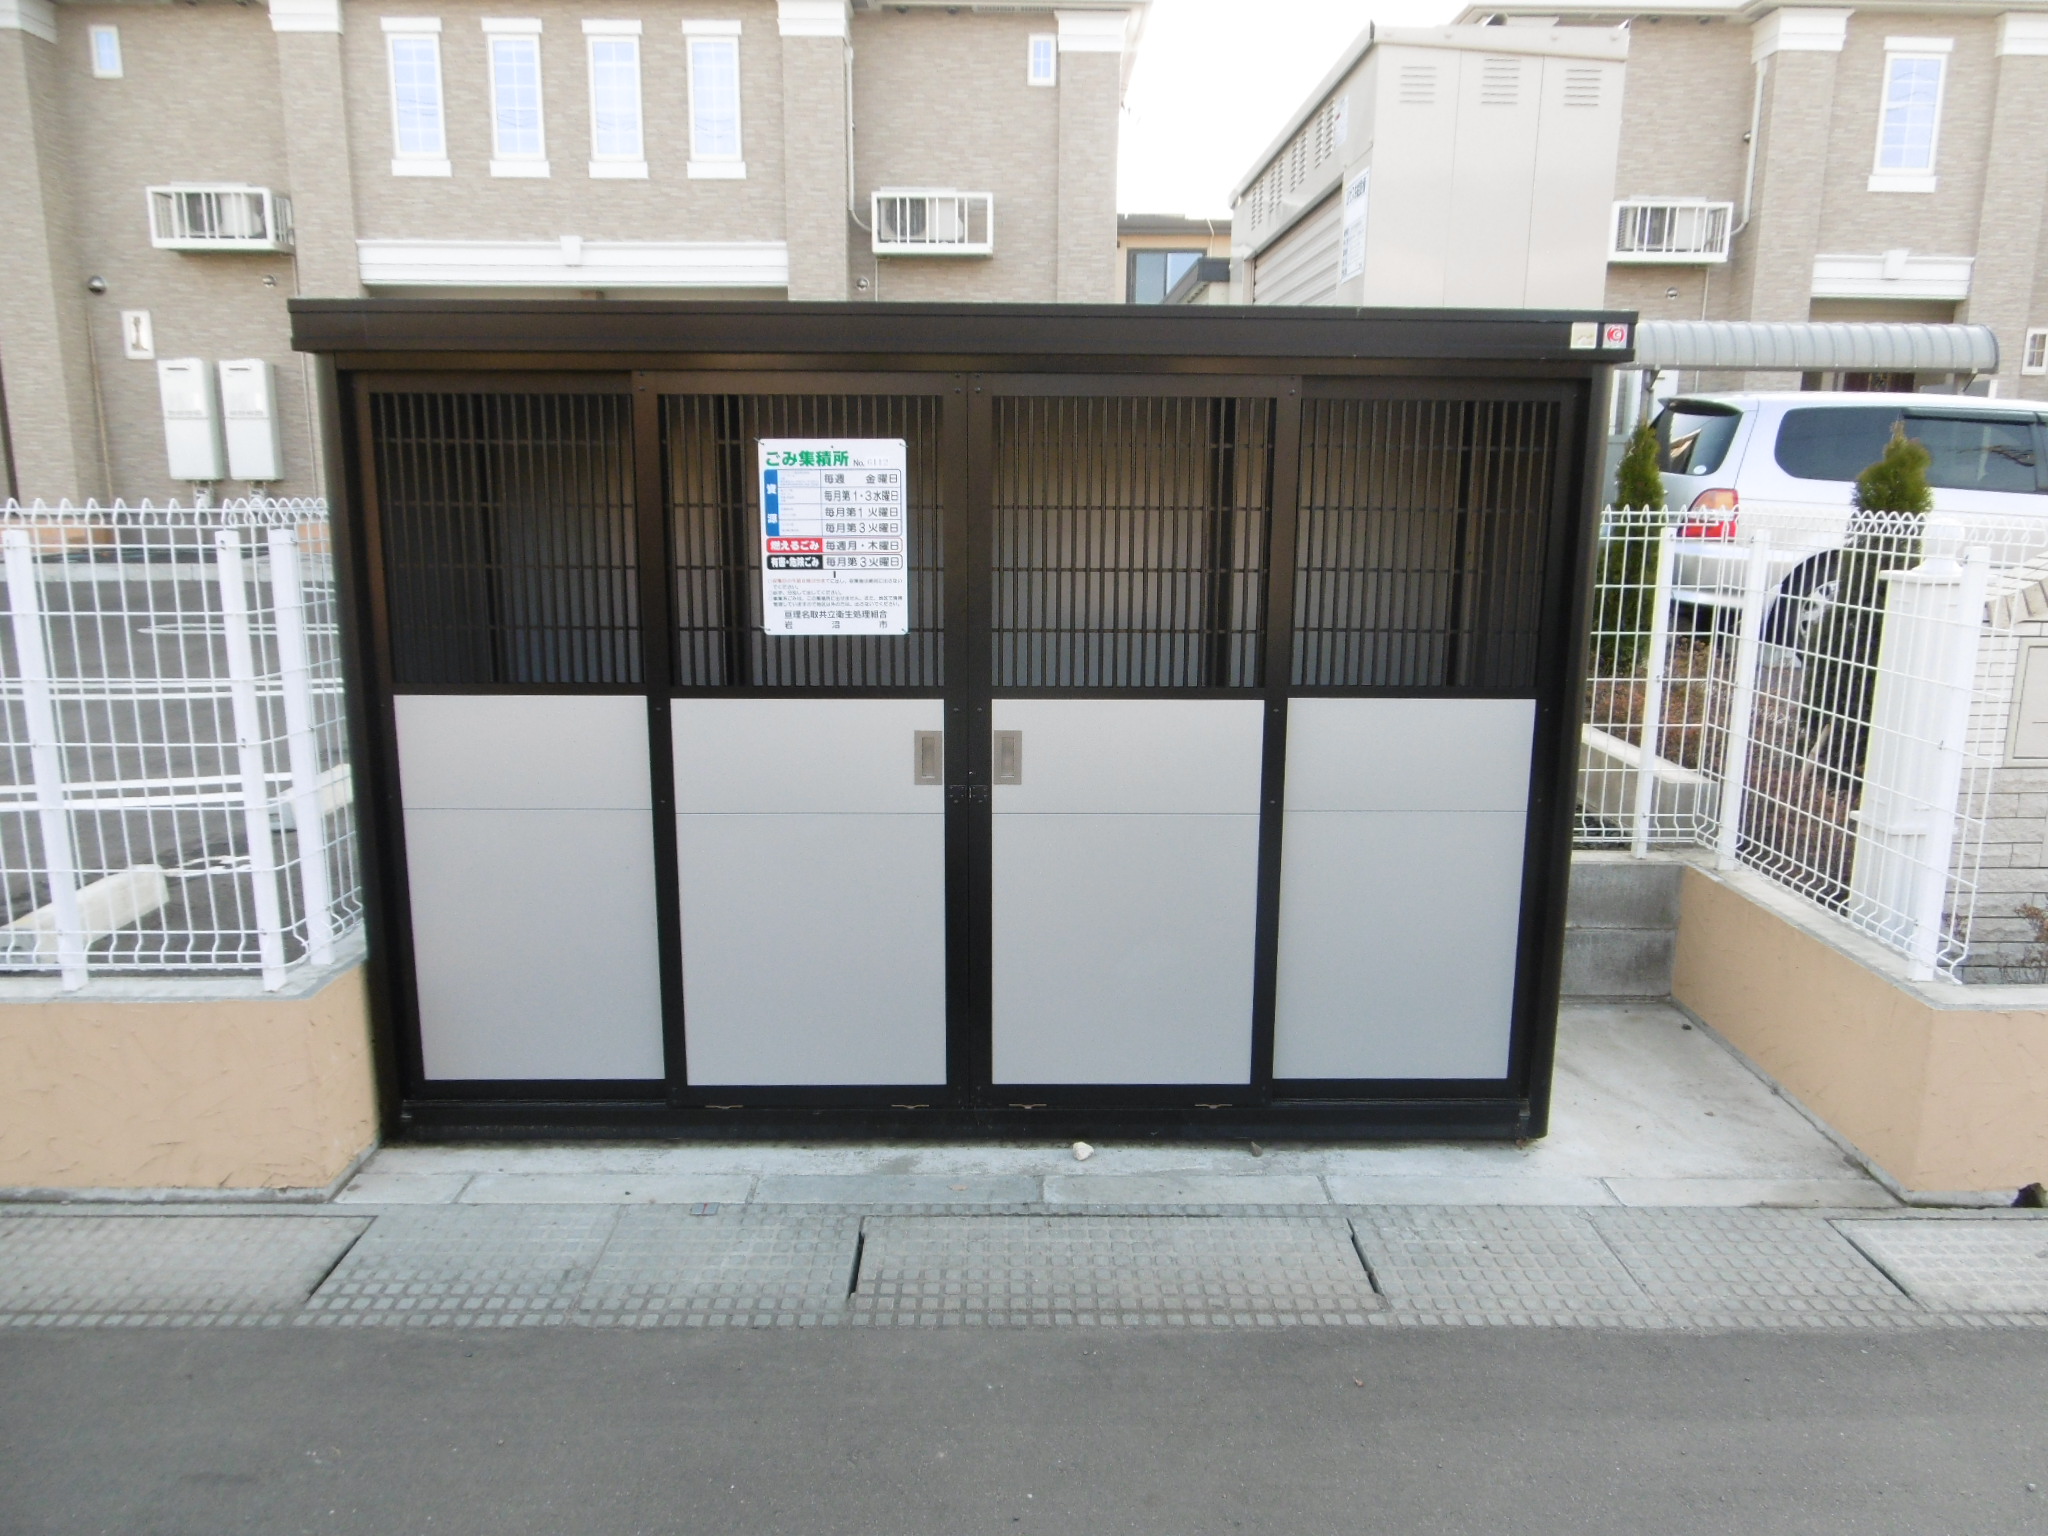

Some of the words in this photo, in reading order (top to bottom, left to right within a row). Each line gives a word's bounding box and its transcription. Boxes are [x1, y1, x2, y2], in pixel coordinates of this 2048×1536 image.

[766, 450, 849, 467] ごみ集積所
[824, 473, 845, 484] 毎週
[865, 473, 898, 484] 金曜日
